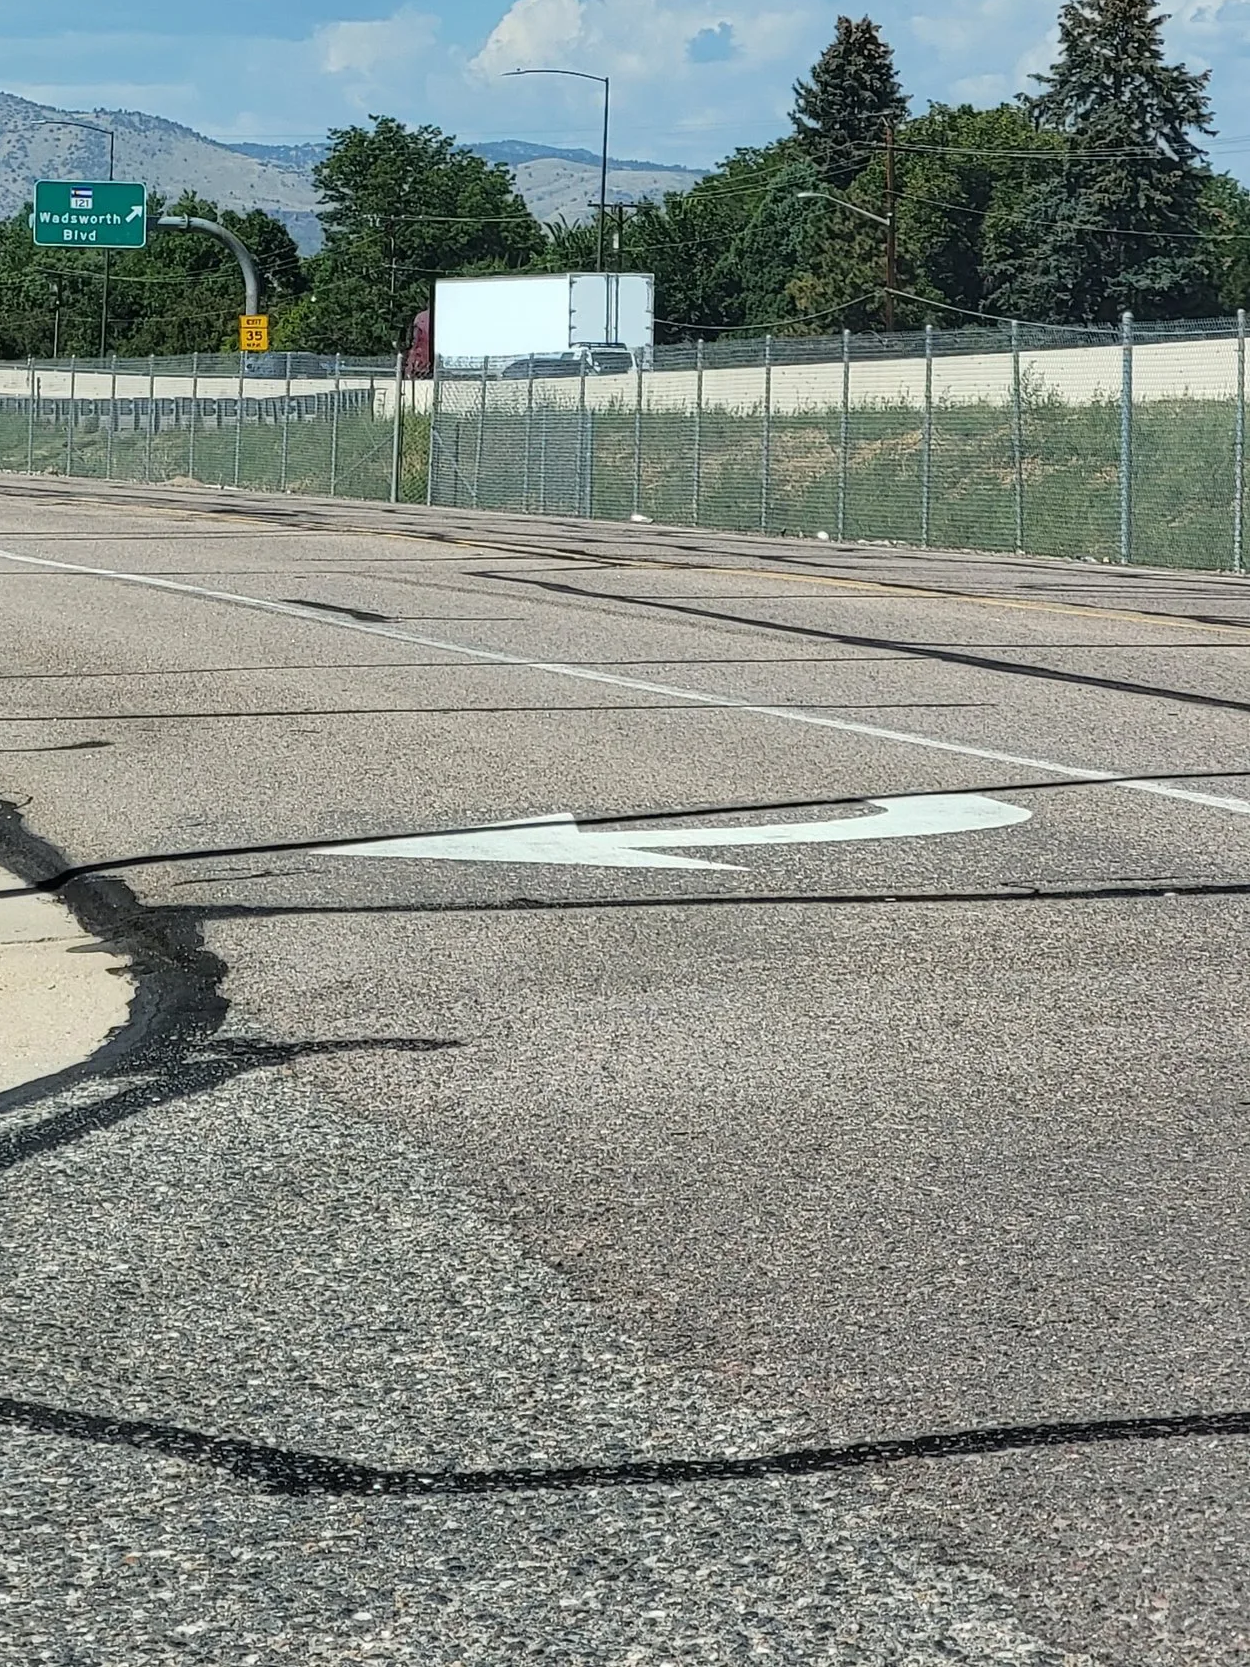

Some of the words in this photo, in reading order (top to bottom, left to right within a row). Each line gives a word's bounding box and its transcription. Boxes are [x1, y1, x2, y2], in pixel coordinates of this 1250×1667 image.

[74, 199, 89, 208] 121
[39, 212, 121, 225] Wadsworth
[63, 229, 97, 241] Blvd
[246, 330, 263, 341] 35
